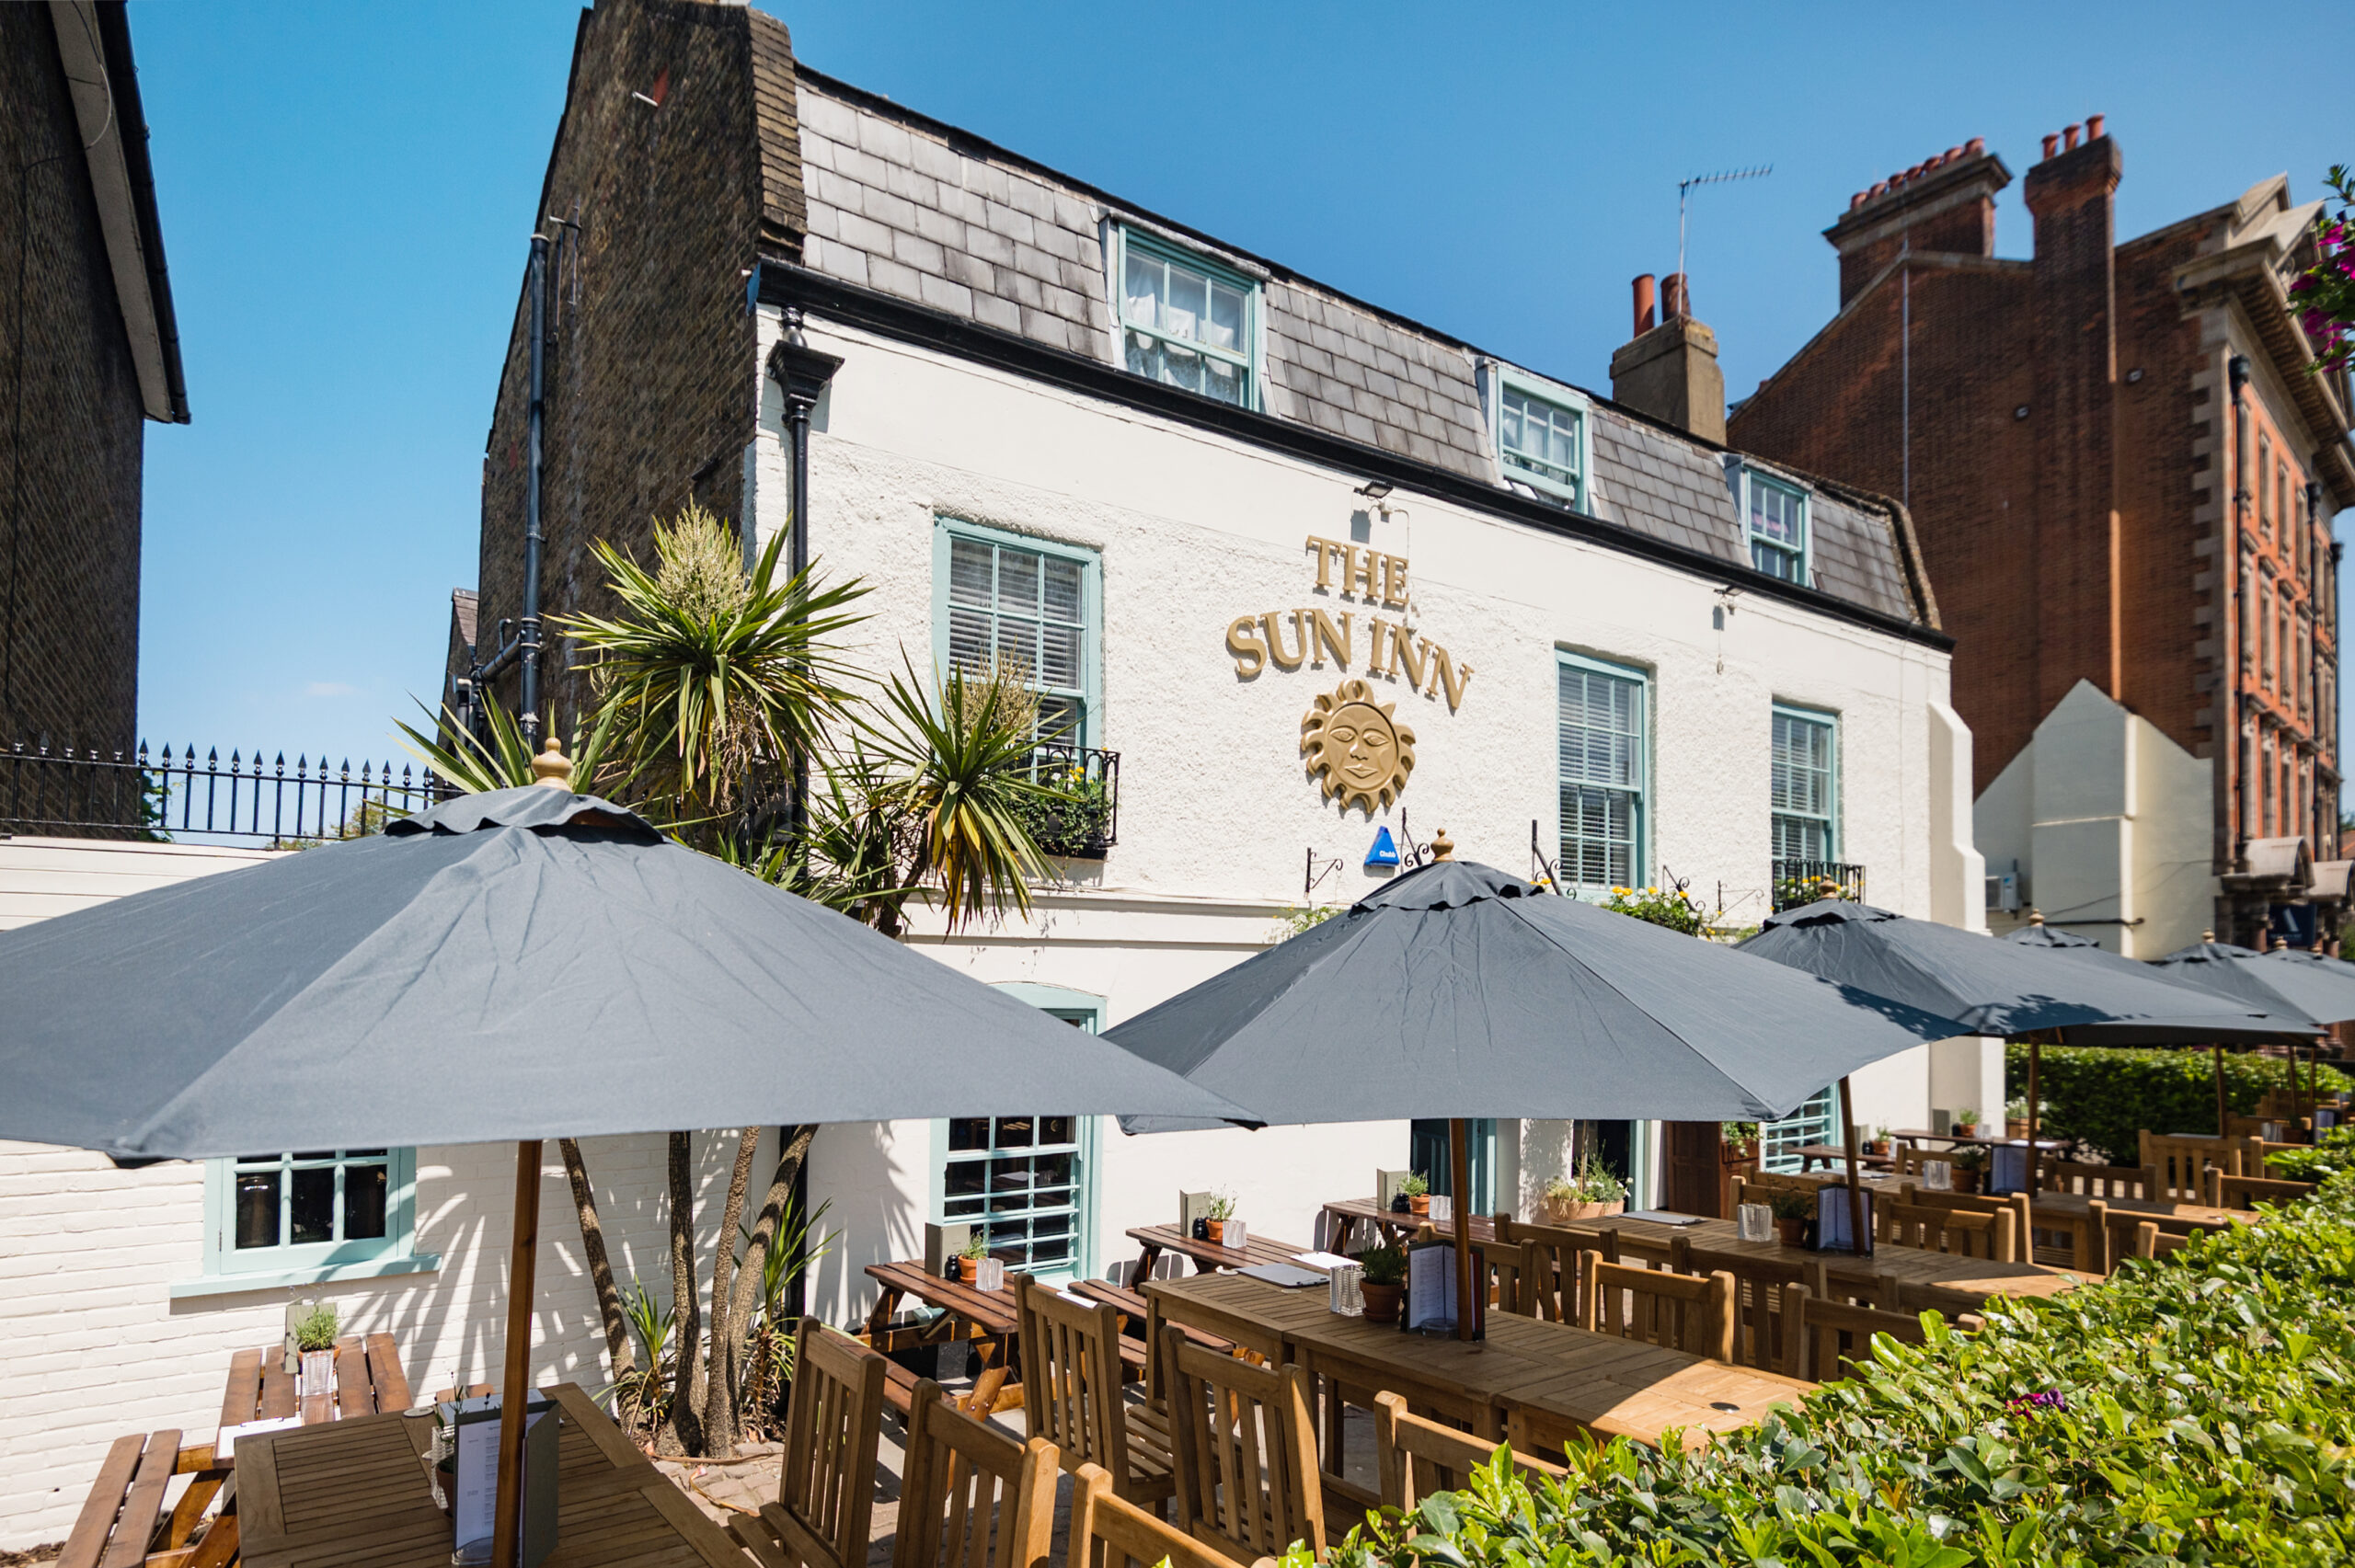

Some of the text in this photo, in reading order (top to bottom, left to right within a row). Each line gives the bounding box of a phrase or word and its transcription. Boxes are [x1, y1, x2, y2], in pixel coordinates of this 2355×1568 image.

[1306, 535, 1409, 604] THE
[1226, 608, 1475, 710] SUN INN
